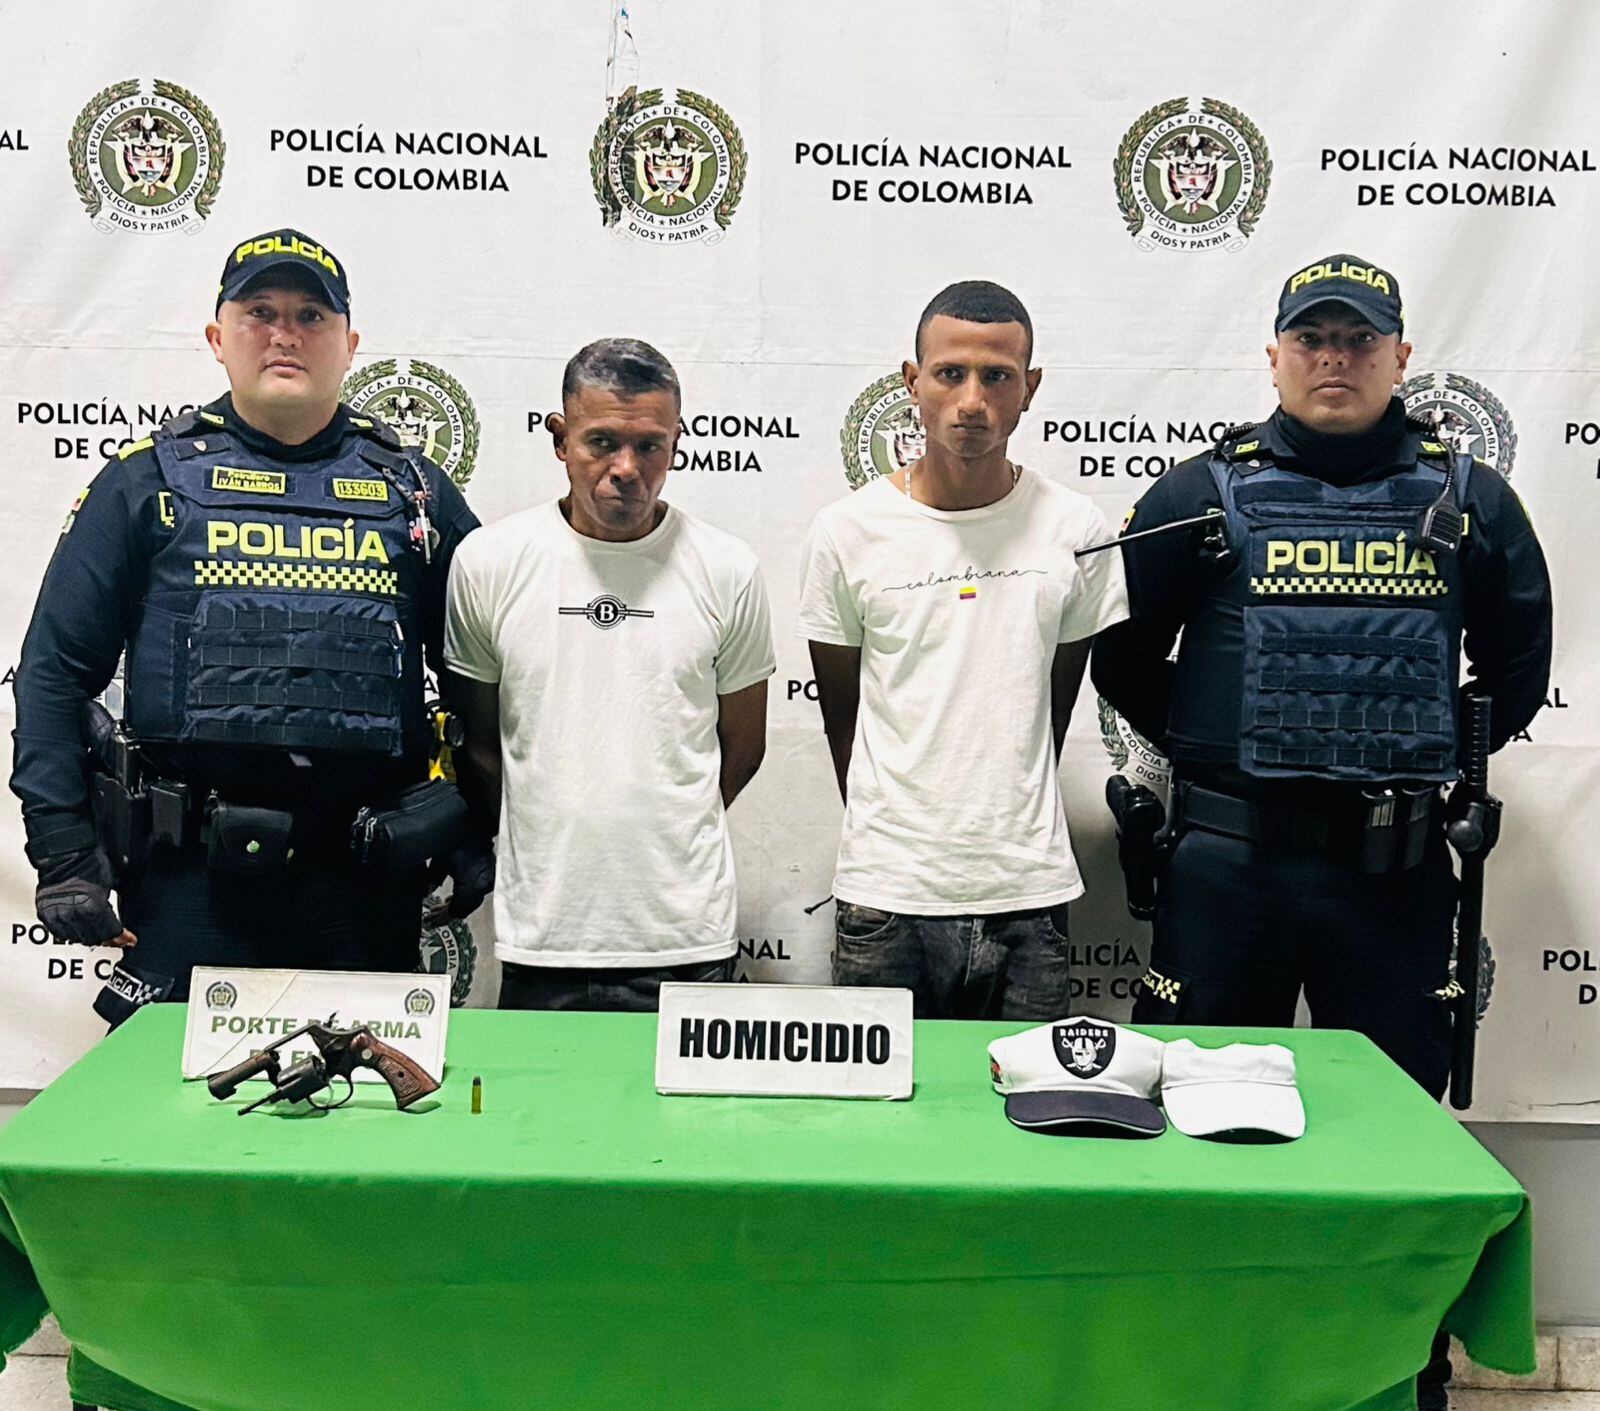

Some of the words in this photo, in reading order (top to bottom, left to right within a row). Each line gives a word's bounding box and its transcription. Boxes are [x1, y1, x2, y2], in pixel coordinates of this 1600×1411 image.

[89, 101, 129, 164] REPUBLICA
[141, 97, 158, 106] DE
[171, 105, 207, 167] COLOMBIA
[270, 123, 385, 154] POLICÍA
[395, 132, 548, 158] NACIONAL
[663, 107, 682, 115] DE
[693, 115, 728, 177] COLOMBIA
[795, 137, 910, 167] POLICÍA
[919, 145, 1072, 170] NACIONAL
[1134, 120, 1176, 183] REPUBLICA
[1188, 115, 1205, 124] DE
[1217, 123, 1252, 185] COLOMBIA
[1321, 142, 1438, 172] POLICÍA
[1448, 147, 1597, 172] NACIONAL
[307, 165, 344, 188] DE
[354, 166, 510, 192] COLOMBIA
[832, 179, 868, 202] DE
[878, 180, 1033, 205] COLOMBIA
[151, 182, 201, 216] NACIONAL
[669, 191, 721, 226] NACIONAL
[1357, 184, 1395, 206] DE
[1405, 182, 1556, 207] COLOMBIA
[150, 214, 190, 231] PATRIA
[1191, 199, 1245, 234] NACIONAL
[668, 224, 709, 241] PATRIA
[1190, 231, 1231, 249] PATRIA
[236, 236, 339, 277] POLICÍA
[1290, 262, 1390, 295] POLICÍA
[18, 396, 129, 425] POLICÍA
[352, 381, 385, 410] BLICA
[397, 376, 413, 385] DE
[426, 385, 461, 446] COLOMBIA
[860, 392, 901, 453] REPUBLICA
[1433, 390, 1449, 399] DE
[1461, 398, 1496, 458] COLOMBIA
[1043, 414, 1157, 444] POLICÍA
[54, 437, 89, 460] DE
[673, 450, 762, 472] OMBIA
[1079, 455, 1116, 477] DE
[338, 482, 384, 497] 133603
[207, 519, 389, 564] POLICÍA
[1266, 533, 1437, 576] POLICÍA
[883, 565, 1047, 592] colombiana
[600, 603, 615, 621] B
[441, 929, 457, 970] OMBIA
[1070, 938, 1141, 967] LICÍA
[47, 958, 84, 980] DE
[1069, 977, 1100, 998] DE
[211, 1016, 298, 1035] PORTE
[1060, 1028, 1109, 1037] RAIDERS
[679, 1017, 891, 1065] HOMICIDIO
